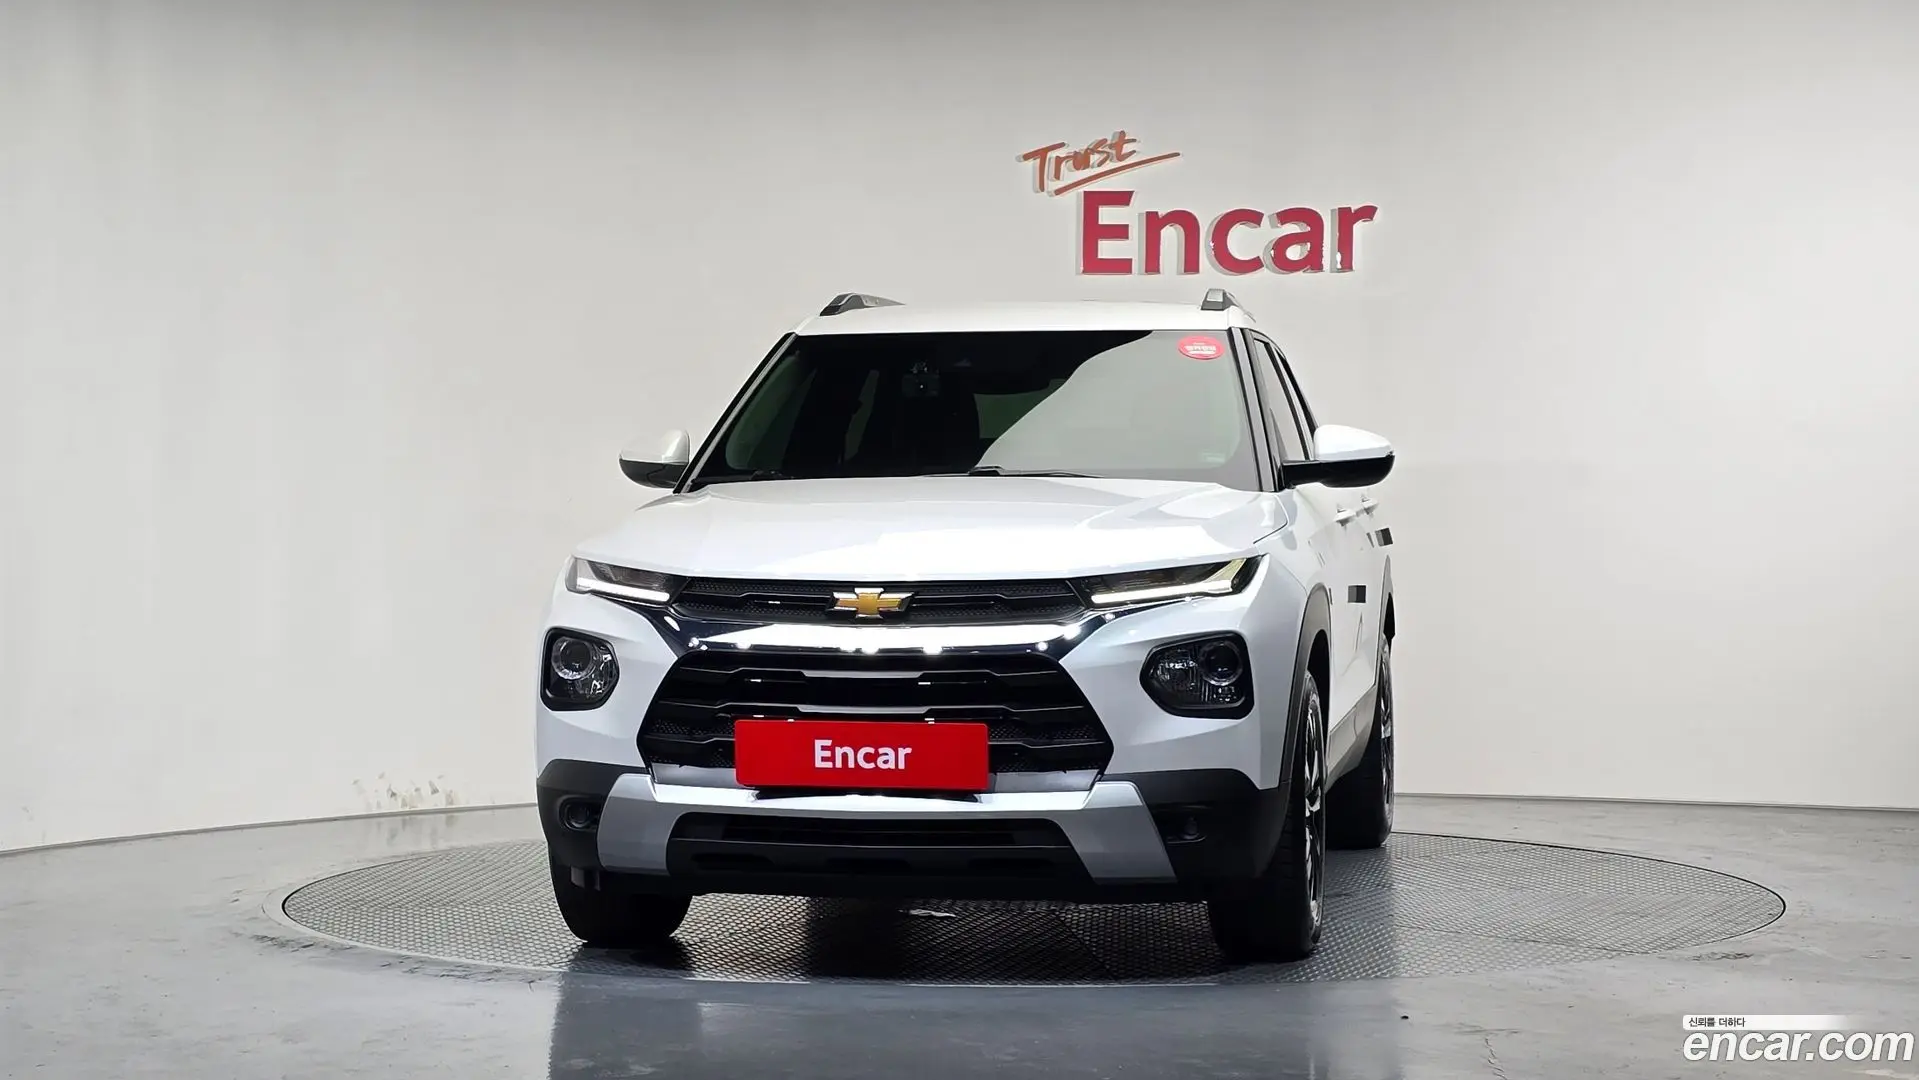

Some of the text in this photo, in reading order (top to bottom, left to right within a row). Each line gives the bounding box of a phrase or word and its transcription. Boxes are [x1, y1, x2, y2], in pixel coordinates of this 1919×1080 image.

[1020, 130, 1139, 193] Trust
[1079, 189, 1378, 275] Encar
[814, 739, 912, 769] Encar
